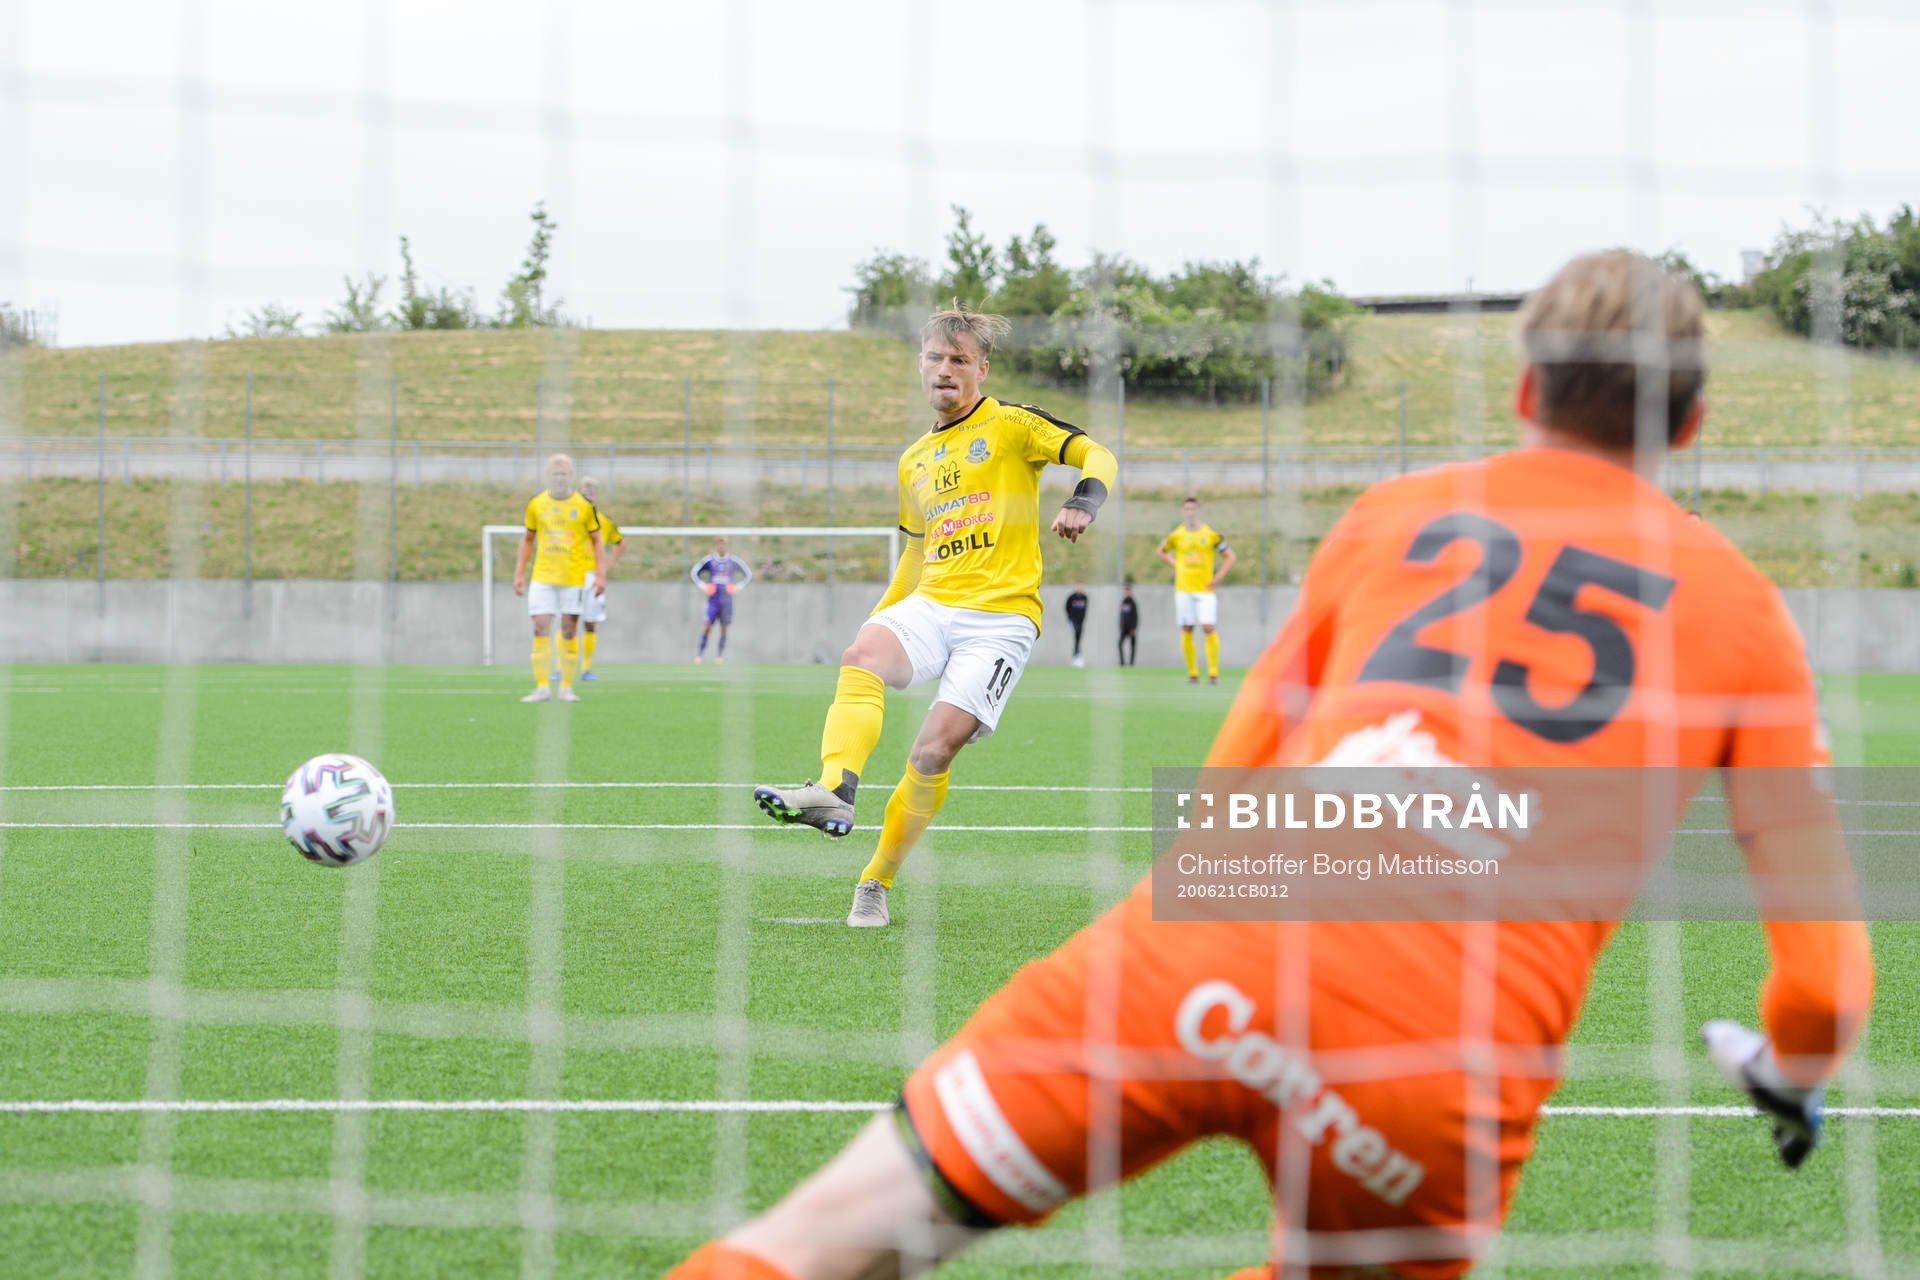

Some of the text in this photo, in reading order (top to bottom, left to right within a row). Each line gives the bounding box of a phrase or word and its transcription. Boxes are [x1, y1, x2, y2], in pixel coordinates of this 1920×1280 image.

[934, 469, 961, 492] LKF
[987, 657, 1013, 701] 19
[1356, 511, 1678, 744] 25
[1174, 979, 1426, 1207] Corren
